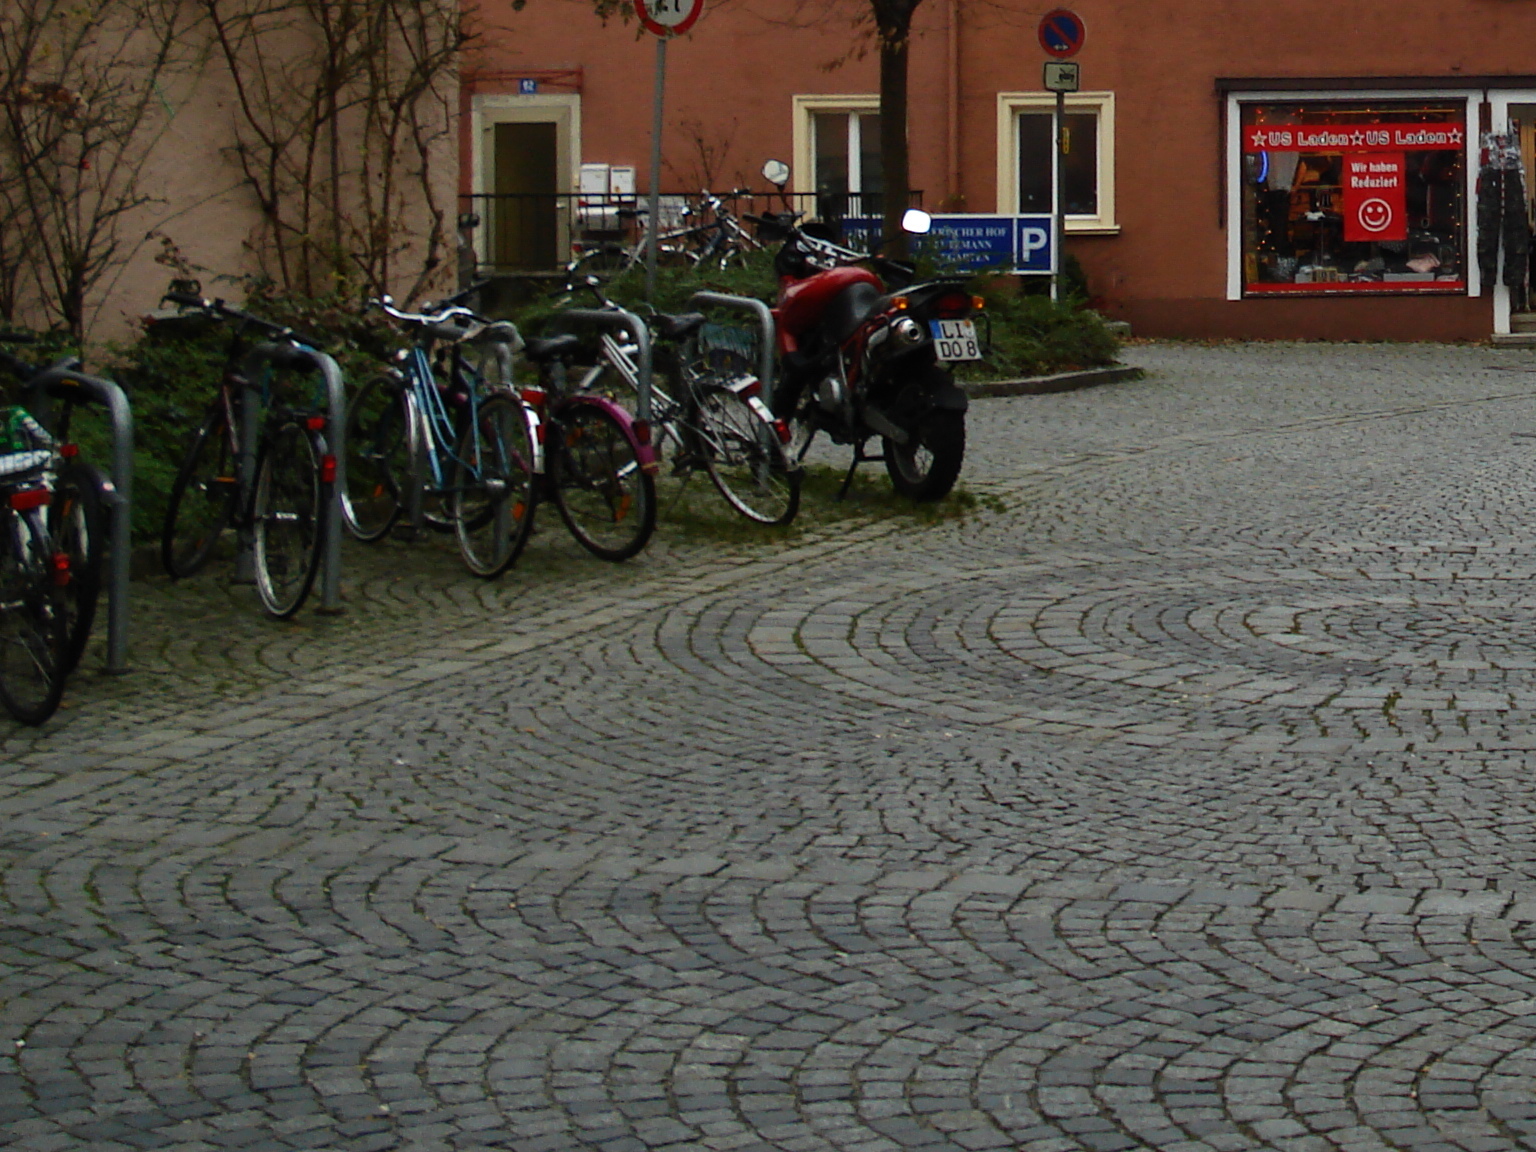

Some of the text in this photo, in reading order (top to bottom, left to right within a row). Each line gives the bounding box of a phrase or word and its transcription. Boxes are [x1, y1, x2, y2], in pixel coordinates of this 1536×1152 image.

[1268, 129, 1446, 146] US Laden US Laden
[1350, 161, 1398, 173] Wir haben
[1350, 176, 1398, 189] Reduziert
[927, 226, 1007, 238] ERISCHER HOF
[1022, 227, 1048, 263] P
[941, 322, 964, 338] LI
[940, 340, 977, 357] DO 8
